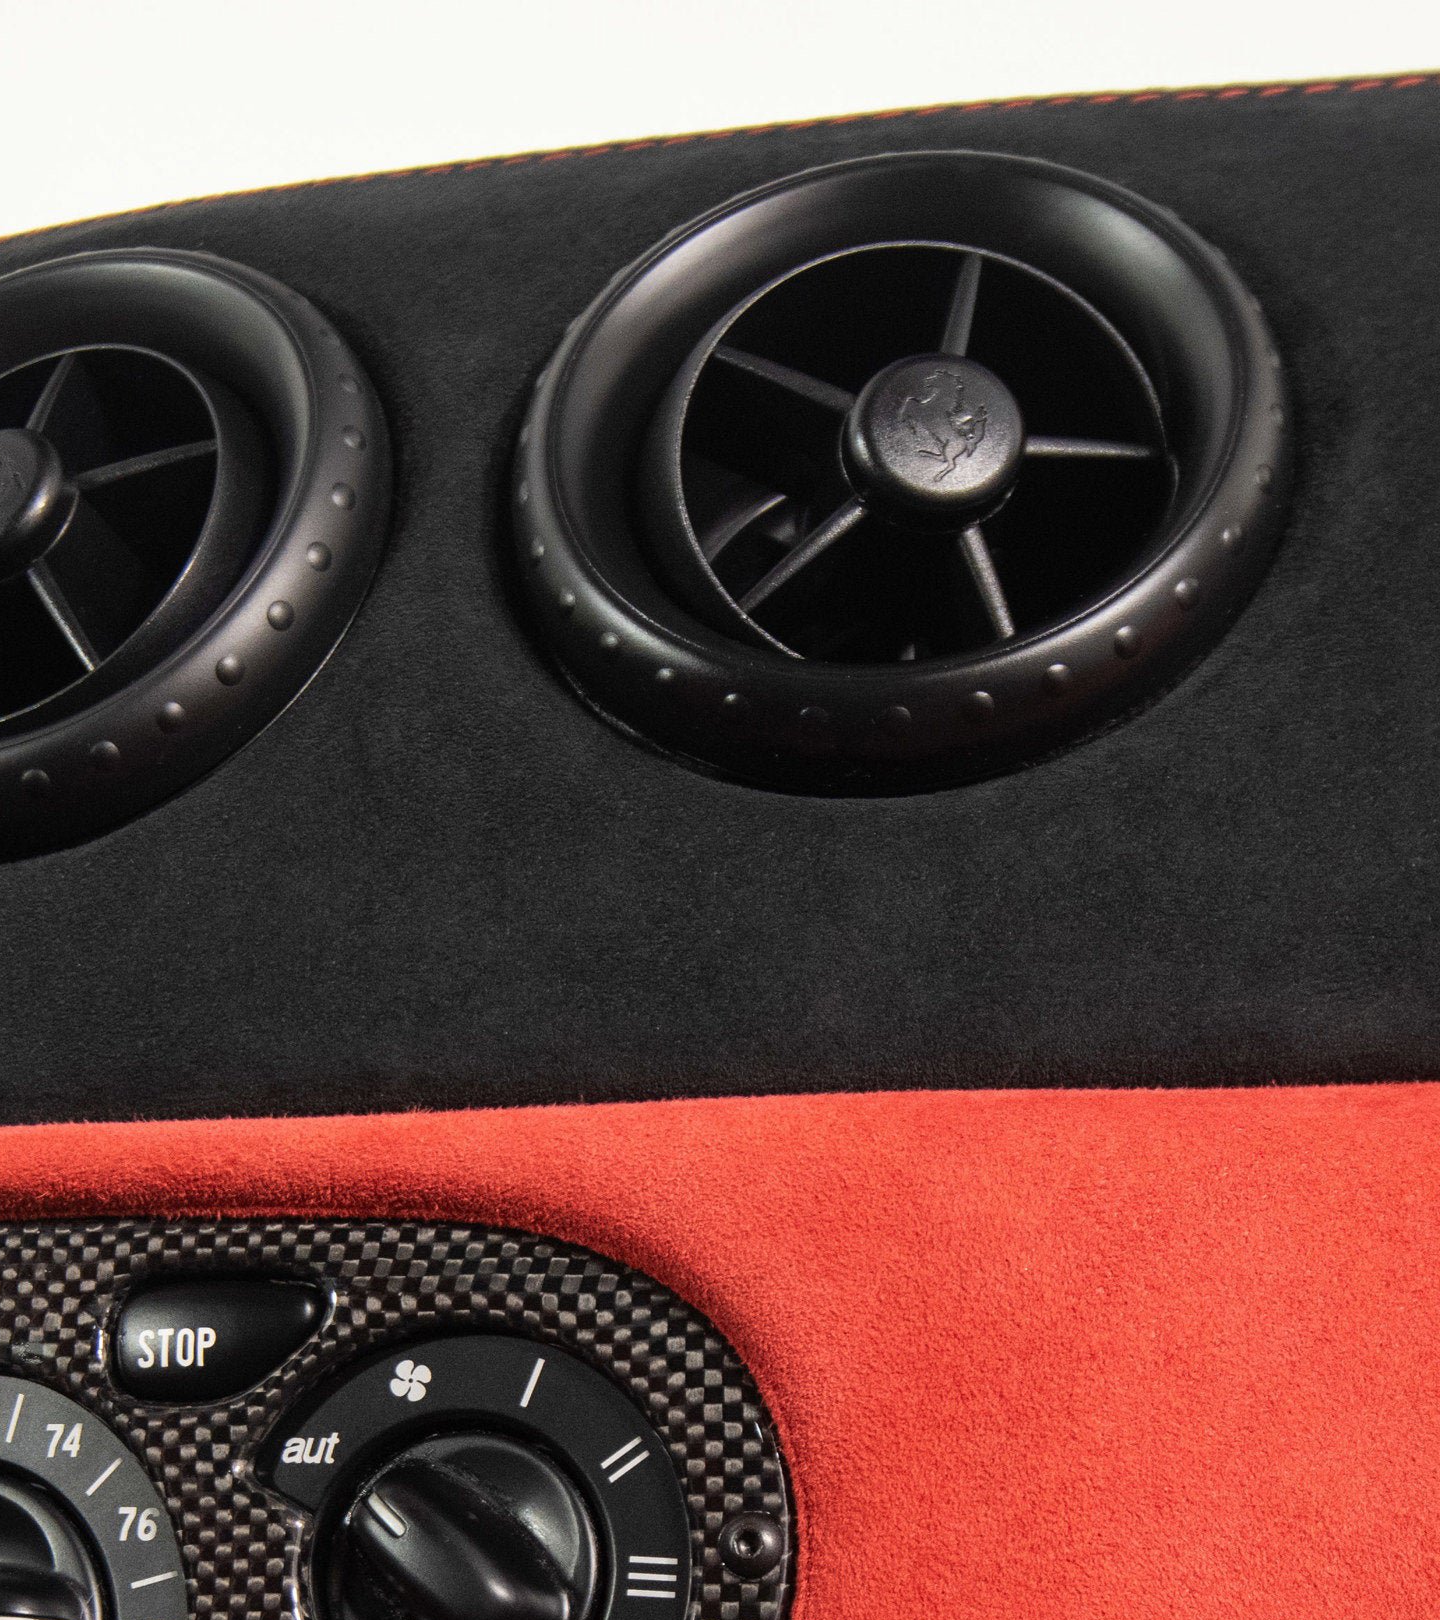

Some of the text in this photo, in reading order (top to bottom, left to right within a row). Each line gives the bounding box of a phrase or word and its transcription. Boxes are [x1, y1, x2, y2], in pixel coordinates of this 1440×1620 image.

[137, 1328, 216, 1368] STOP
[45, 1423, 83, 1458] 74
[281, 1431, 340, 1465] aut
[118, 1506, 158, 1542] 76
